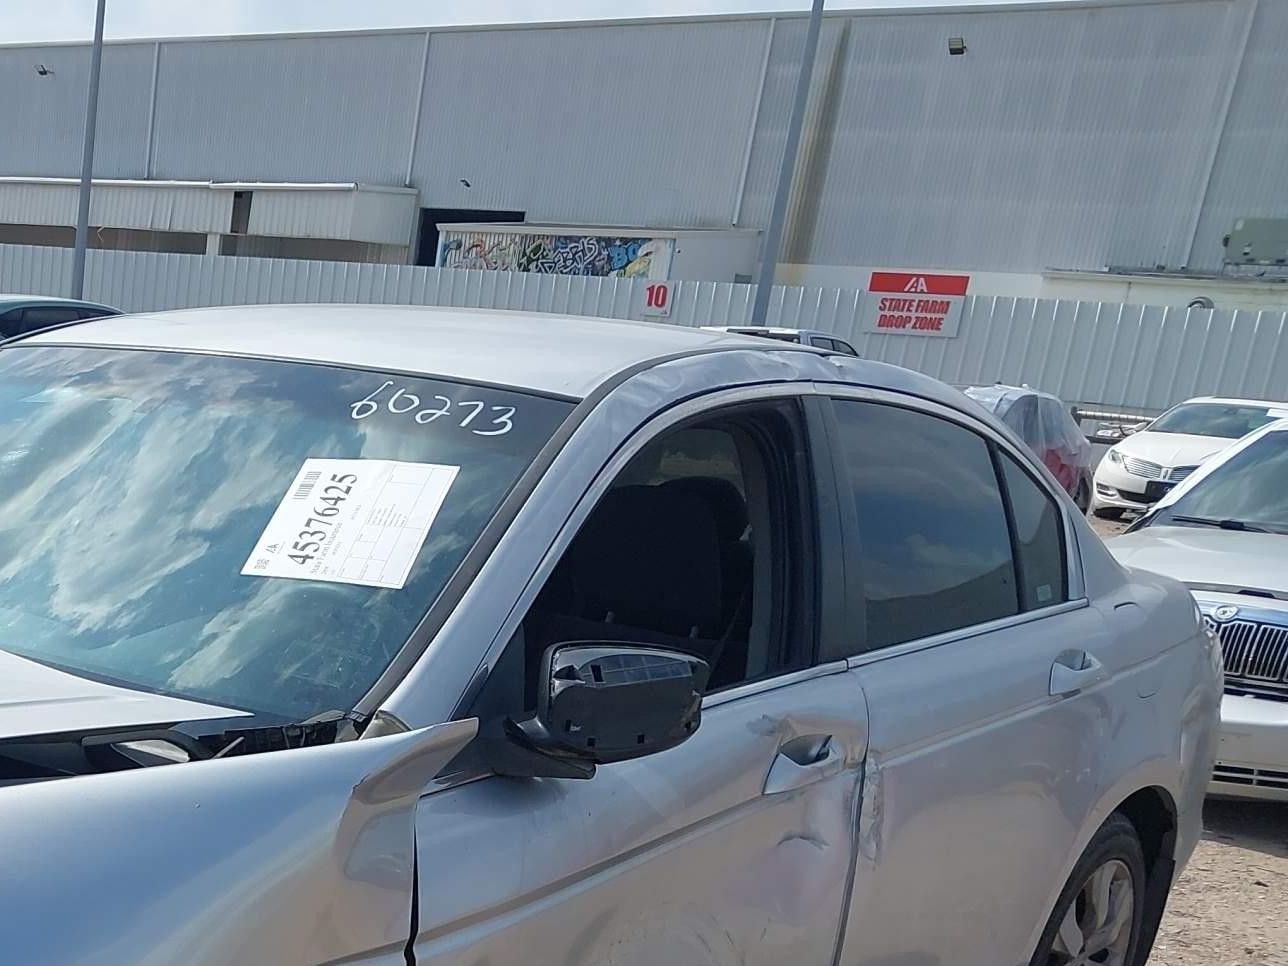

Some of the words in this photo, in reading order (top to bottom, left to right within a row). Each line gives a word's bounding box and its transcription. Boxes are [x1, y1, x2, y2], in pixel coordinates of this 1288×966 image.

[647, 284, 667, 308] 10
[878, 297, 915, 313] STATE
[915, 300, 951, 315] FARM
[878, 314, 911, 329] DROP
[912, 316, 944, 331] ZONE
[350, 380, 516, 436] 60273
[288, 474, 358, 566] 45376425
